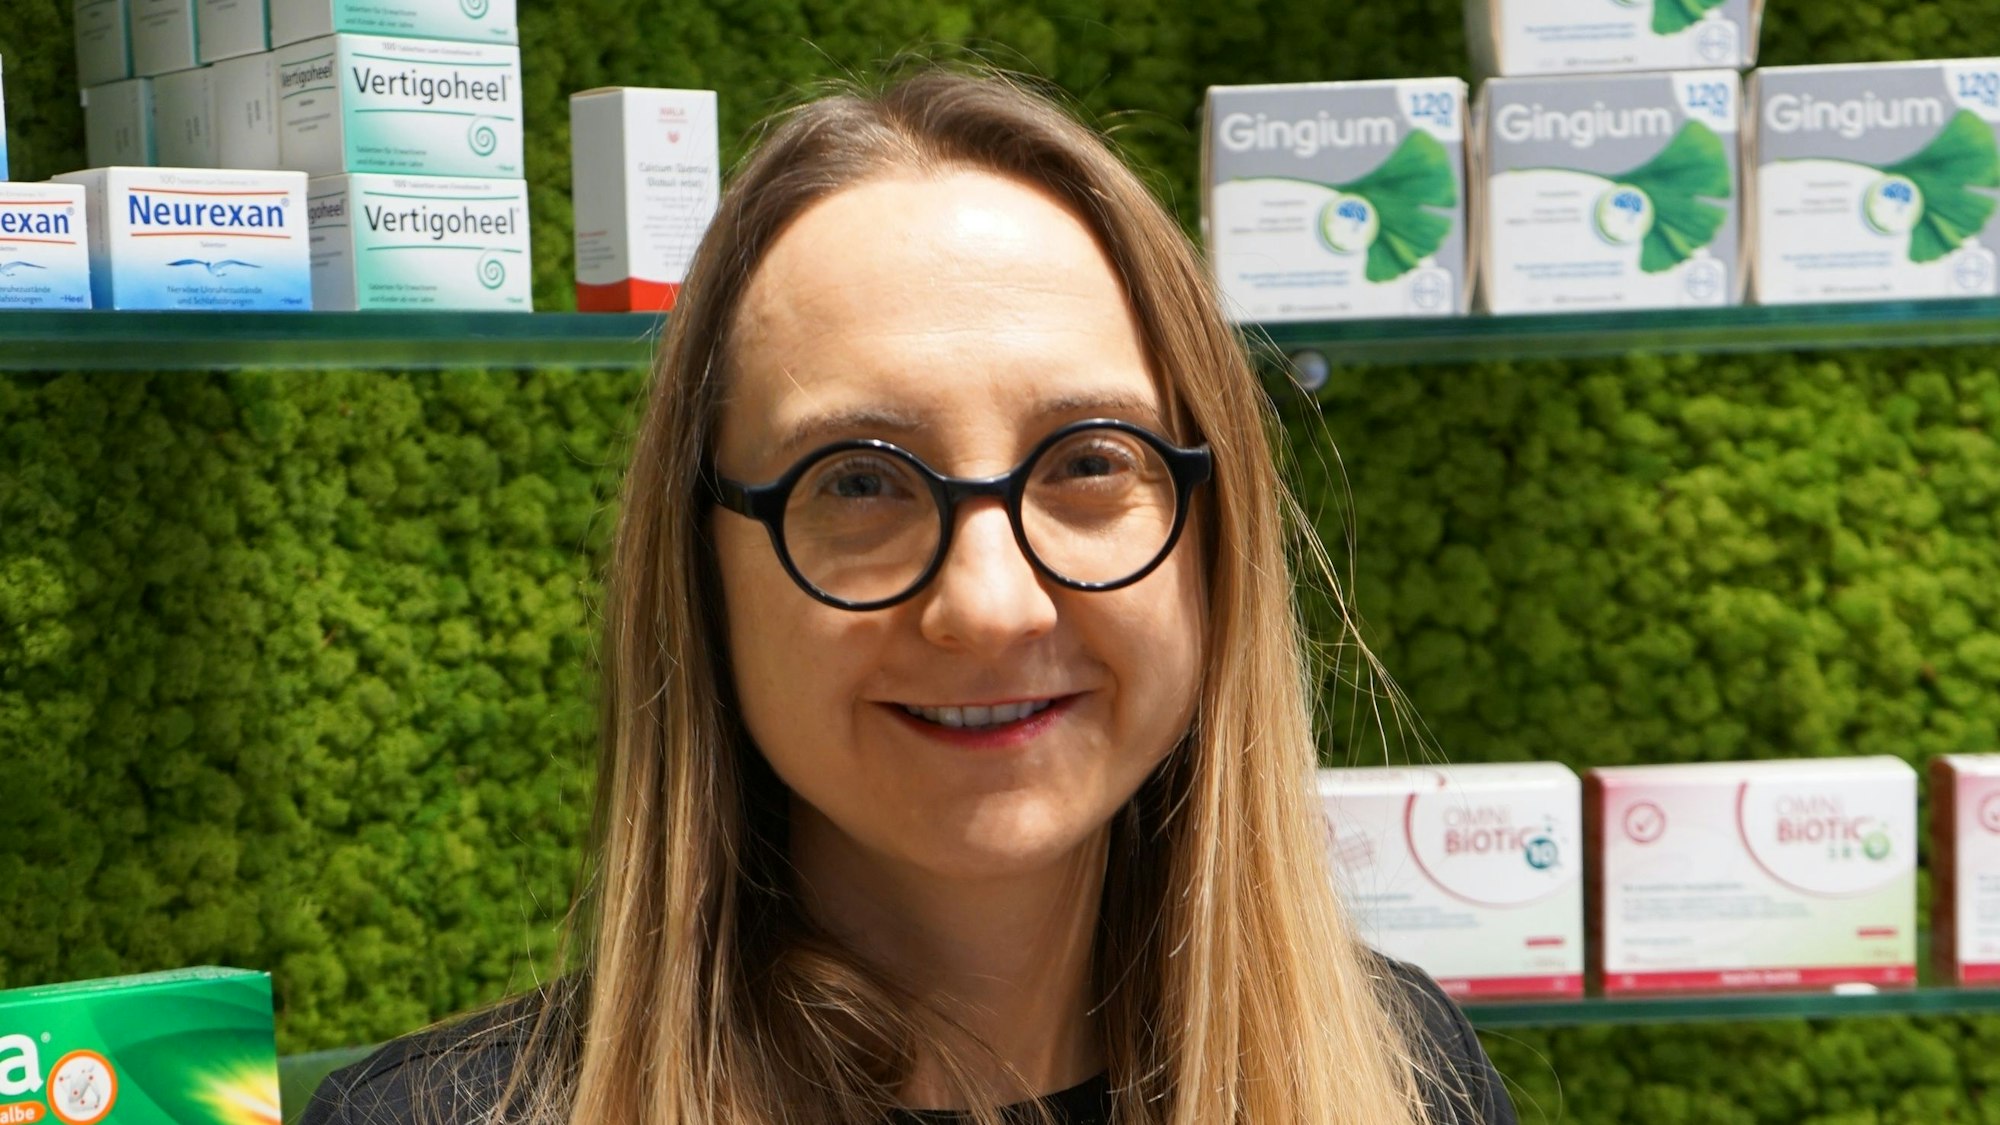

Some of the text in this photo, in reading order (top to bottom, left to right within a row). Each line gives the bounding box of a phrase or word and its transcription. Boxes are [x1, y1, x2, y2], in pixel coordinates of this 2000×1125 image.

[1220, 92, 1454, 158] Gingium 120
[1496, 82, 1729, 148] Gingium 120
[1765, 90, 1944, 138] Gingium
[0, 1104, 35, 1124] albe
